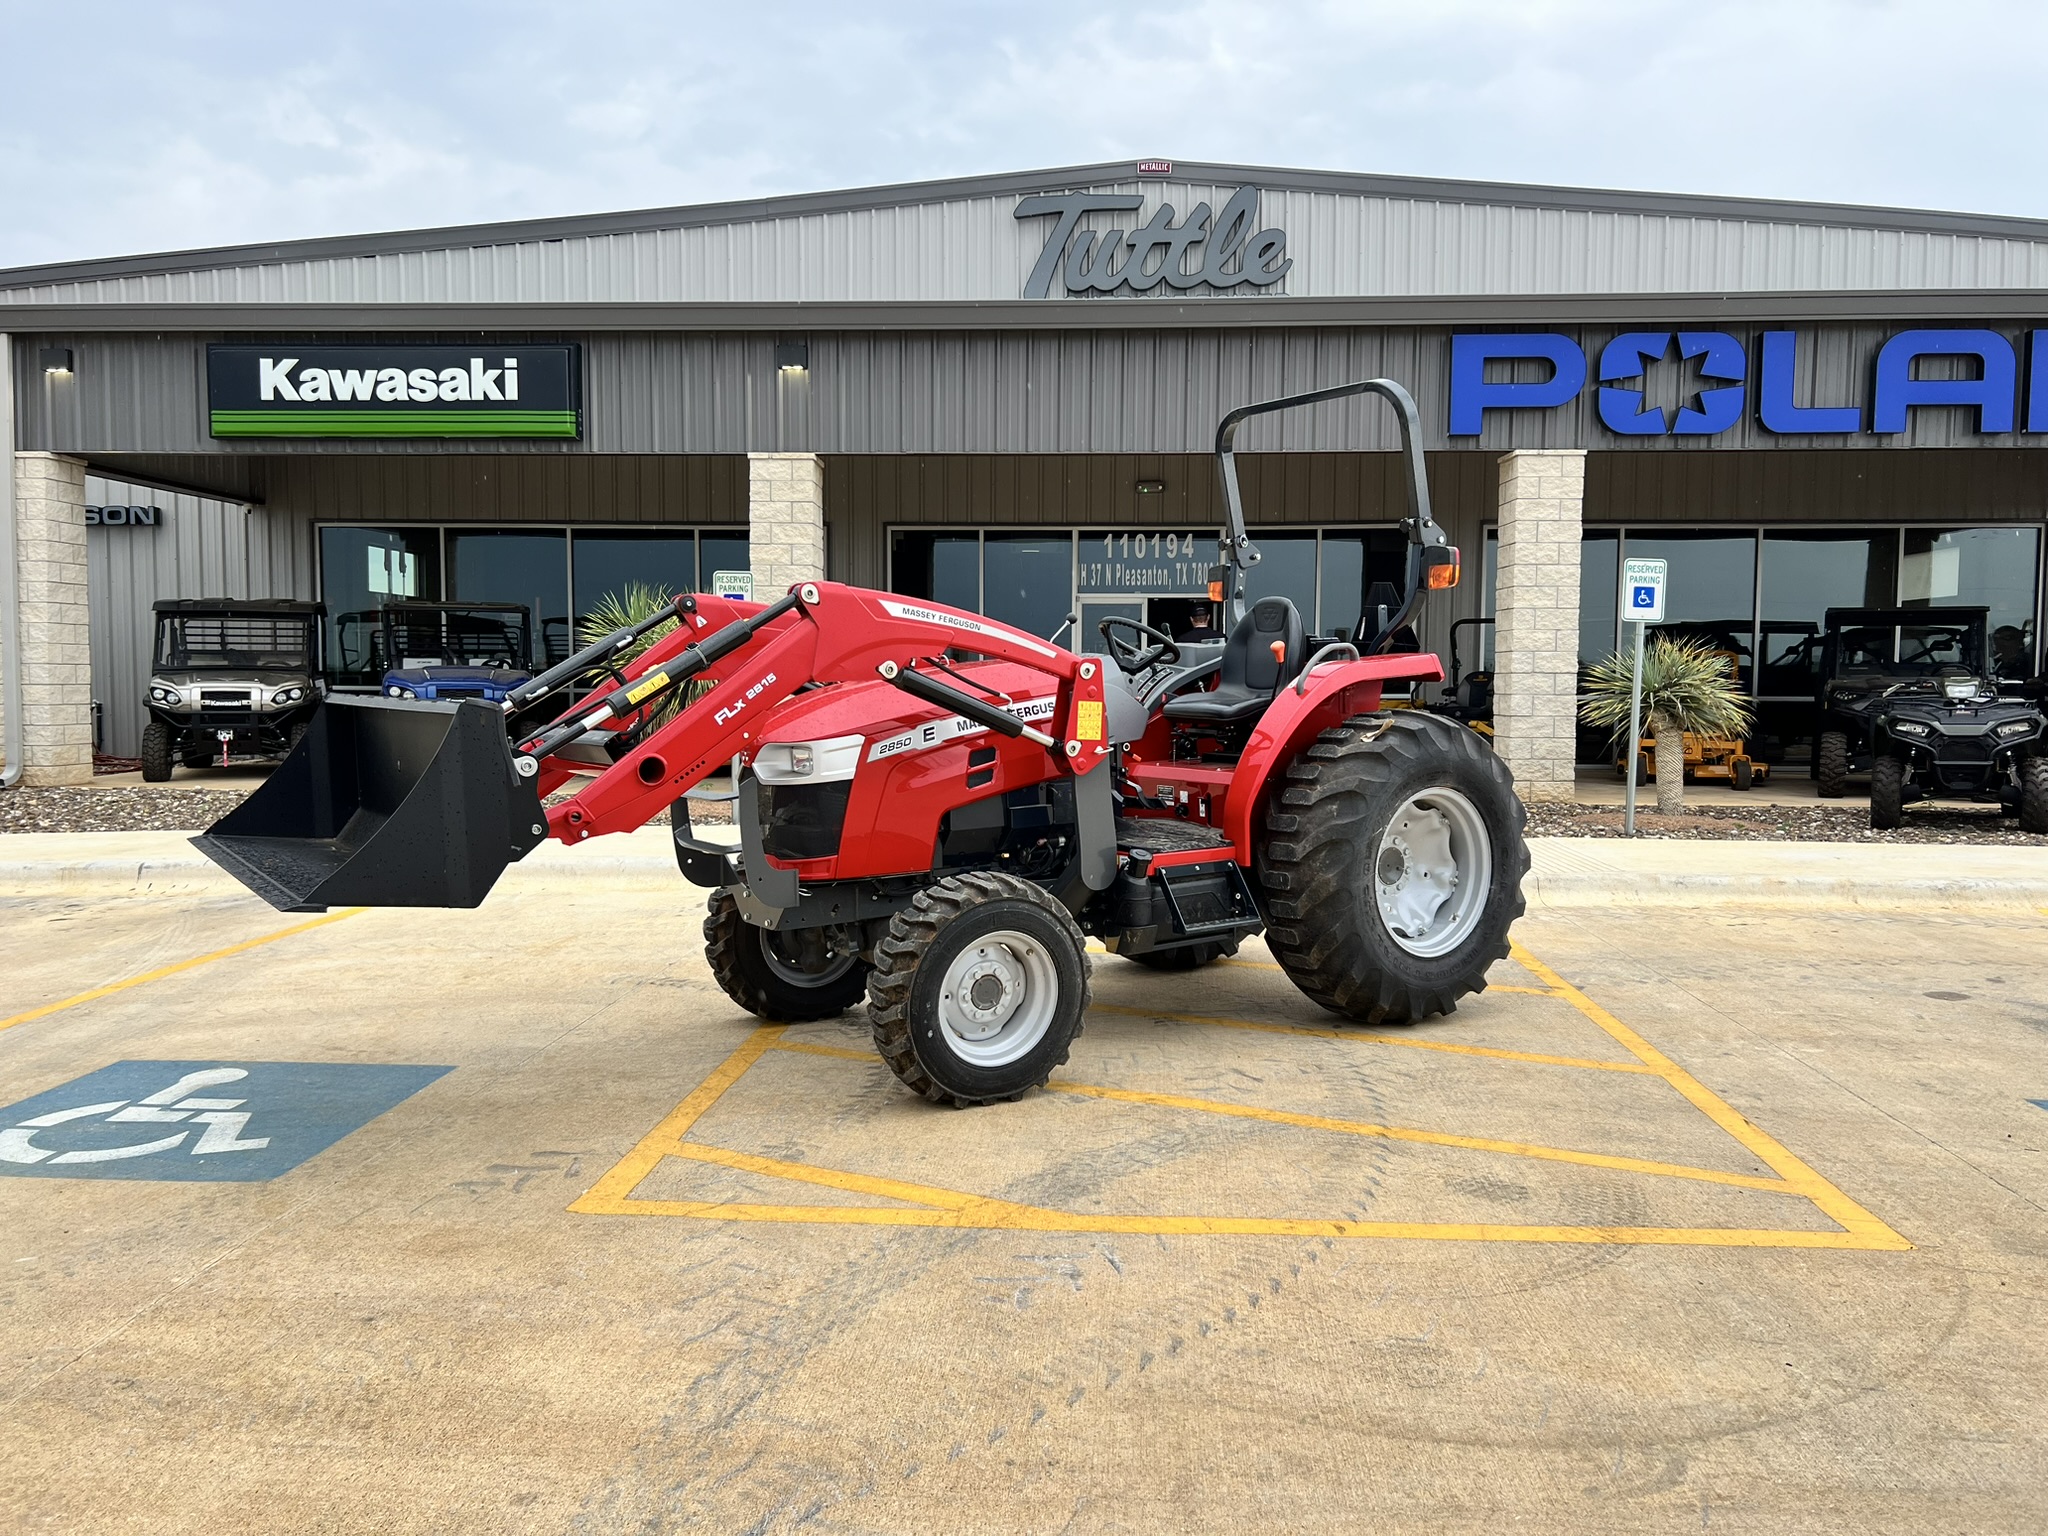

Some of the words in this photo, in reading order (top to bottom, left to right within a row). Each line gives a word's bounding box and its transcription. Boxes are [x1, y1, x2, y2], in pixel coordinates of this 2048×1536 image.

[1140, 162, 1168, 171] METALLIC
[1013, 185, 1293, 299] Tuttle
[259, 357, 518, 402] Kawasaki
[1449, 329, 2048, 435] POLA
[1104, 533, 1194, 559] 110194
[716, 575, 751, 584] RESERVED
[1090, 563, 1101, 586] 37
[1106, 563, 1112, 586] N
[1116, 563, 1172, 590] Pleasanton,
[1176, 563, 1188, 586] TX
[1192, 562, 1219, 586] 780
[1627, 564, 1664, 574] RESERVED
[1629, 575, 1661, 584] PARKING
[719, 584, 749, 593] PARKING
[902, 607, 937, 620] MASSEY
[938, 614, 981, 631] FERGUSON
[745, 672, 777, 700] 2815
[878, 736, 912, 755] 2850
[923, 726, 936, 743] E
[956, 719, 982, 732] MA
